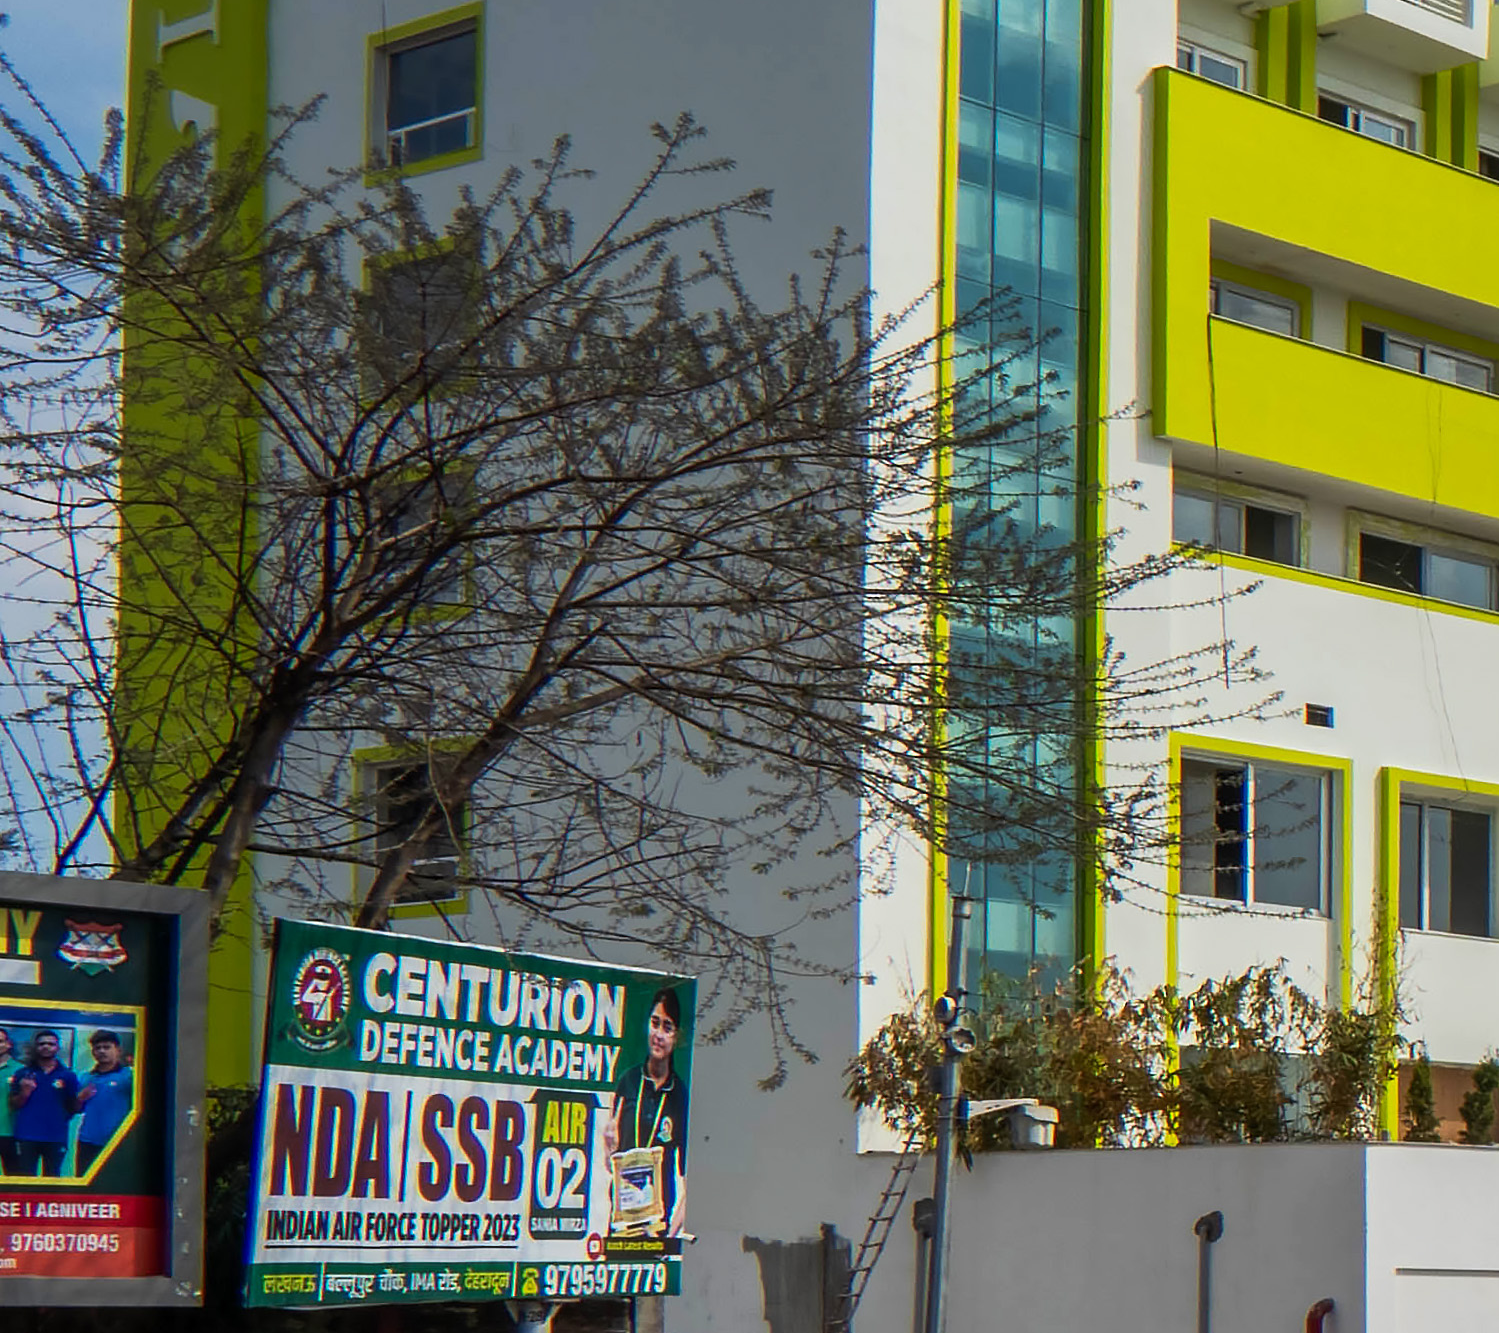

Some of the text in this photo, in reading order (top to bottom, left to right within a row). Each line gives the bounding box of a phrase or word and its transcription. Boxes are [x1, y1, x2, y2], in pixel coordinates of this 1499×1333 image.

[364, 952, 625, 1039] CENTURION
[358, 1018, 621, 1082] DEFENCE ACADEMY
[541, 1101, 588, 1144] AIR
[269, 1084, 525, 1202] NDA SSB
[535, 1147, 587, 1209] 02
[36, 1202, 120, 1219] AGNIVEER
[266, 1210, 521, 1242] INDIAN AIR FORCE TOPPER 2023
[11, 1233, 119, 1252] 9760370945
[263, 1274, 317, 1294] लखनऊ
[410, 1272, 436, 1290] IMA
[464, 1268, 511, 1295] देहरादून
[544, 1263, 667, 1295] 9795977779
